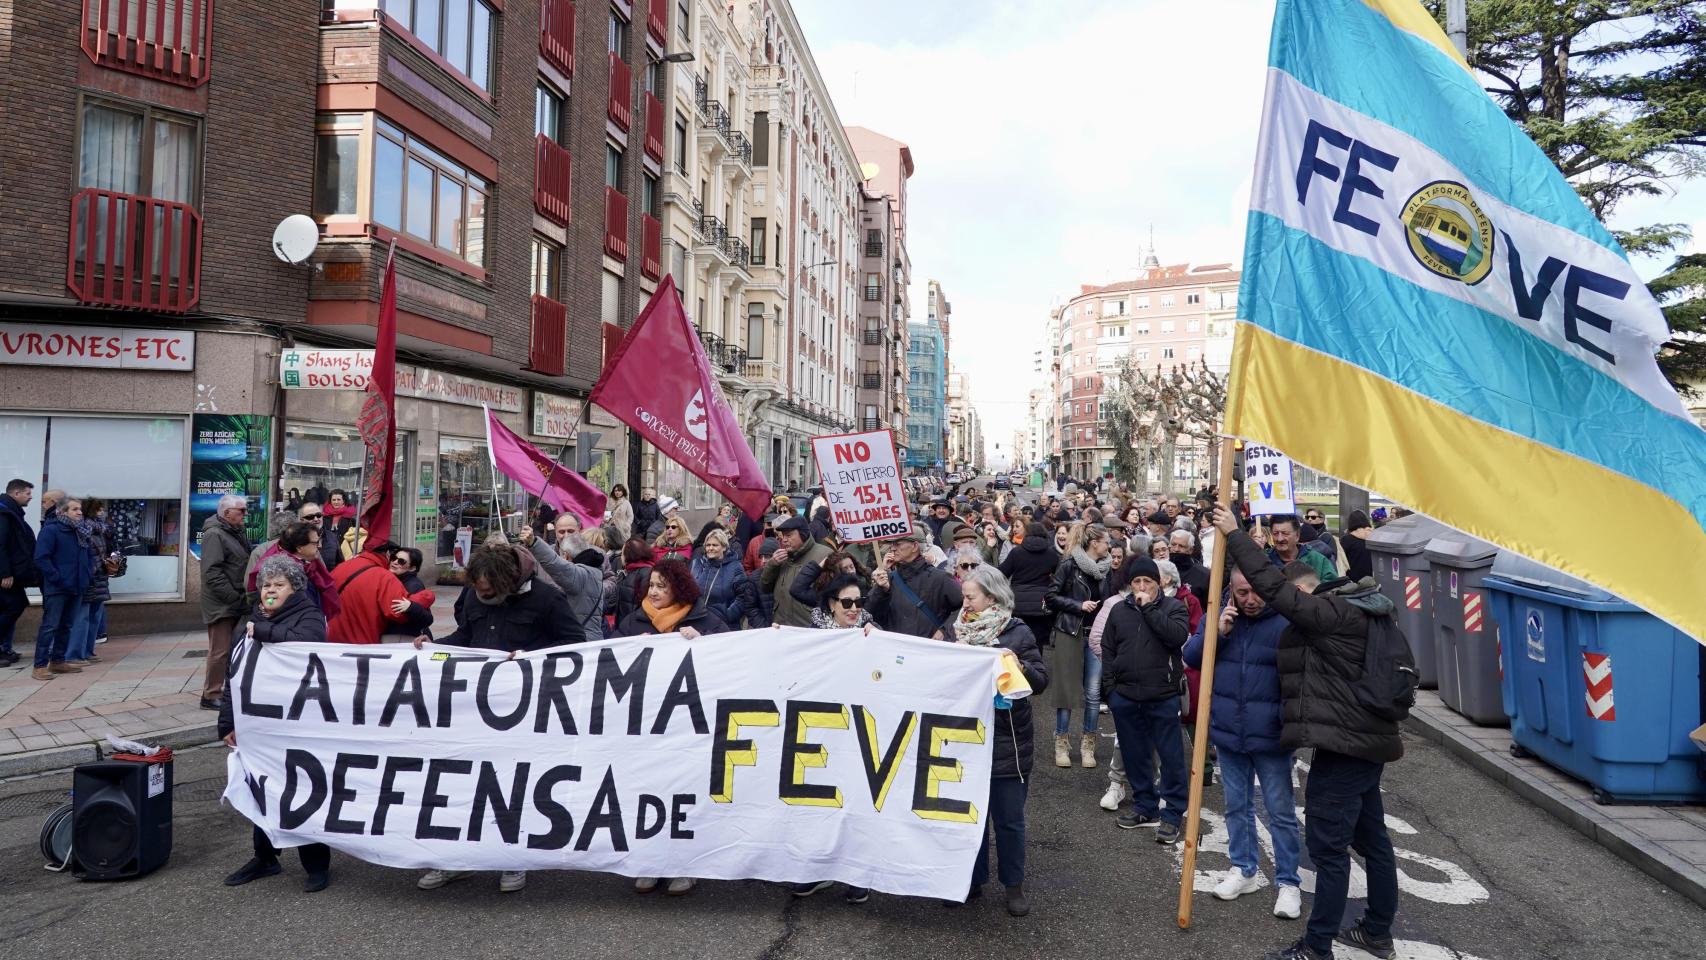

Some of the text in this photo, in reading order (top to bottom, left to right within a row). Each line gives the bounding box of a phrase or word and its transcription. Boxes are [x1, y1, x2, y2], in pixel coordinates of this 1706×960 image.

[1409, 187, 1489, 249] PLATAFORMA DEFENSA
[1297, 119, 1631, 365] FE VE
[1423, 255, 1443, 270] FEVE
[305, 352, 352, 371] Shang
[833, 441, 870, 464] NO
[822, 472, 836, 485] AL
[1263, 463, 1278, 475] DE
[829, 483, 892, 505] DE 15,4
[837, 521, 907, 539] DE EUROS
[280, 748, 629, 852] DEFENSA
[636, 793, 696, 840] DE
[709, 698, 986, 824] FEVE
